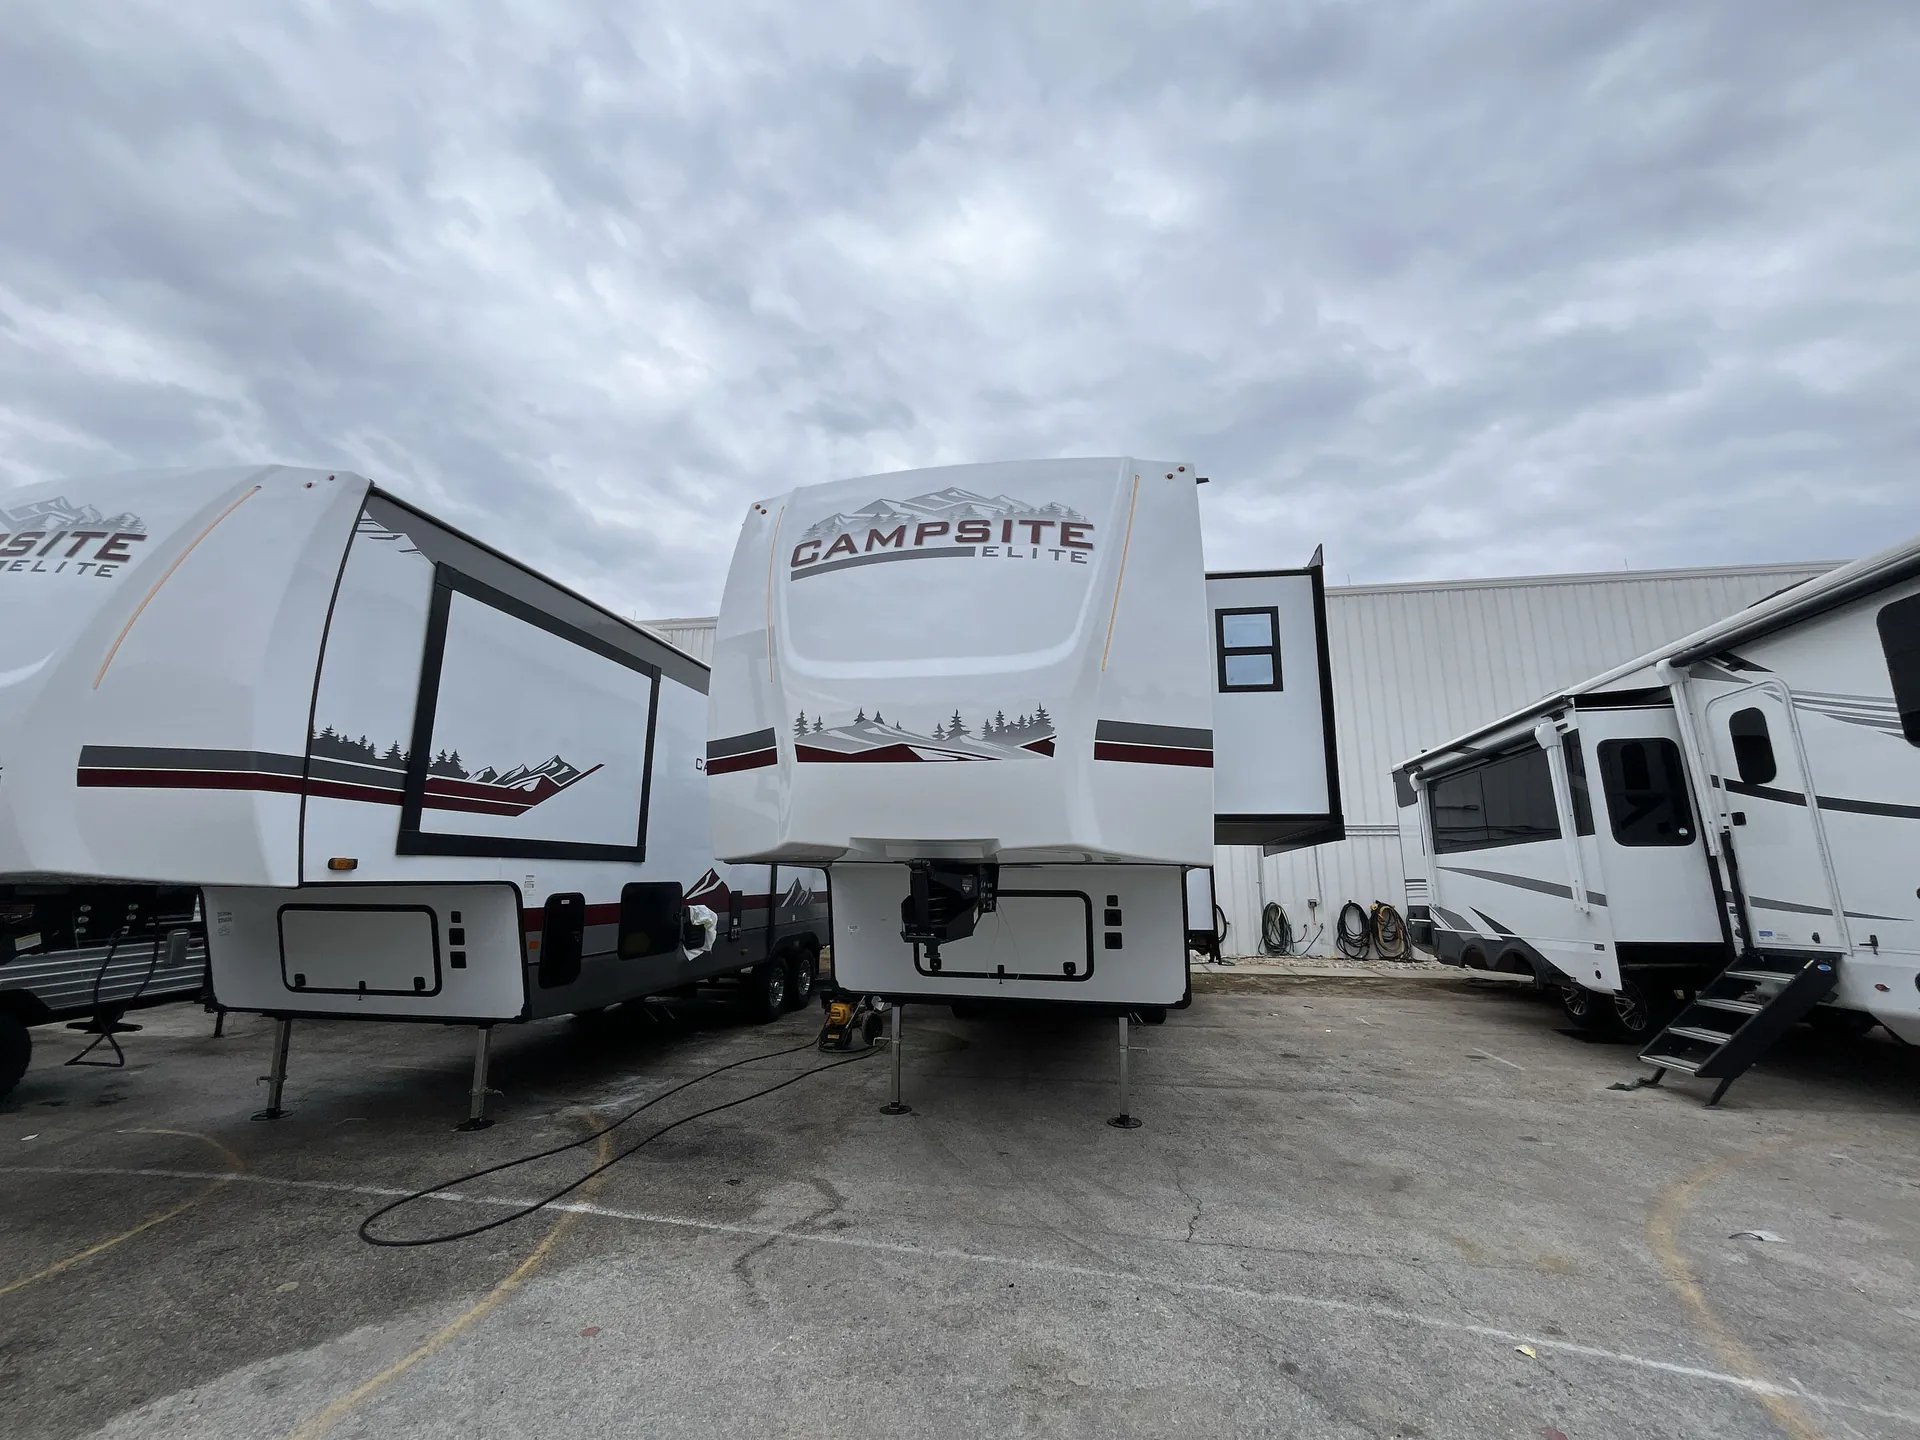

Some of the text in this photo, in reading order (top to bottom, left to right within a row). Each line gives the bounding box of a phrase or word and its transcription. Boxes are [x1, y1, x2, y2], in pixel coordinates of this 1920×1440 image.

[0, 530, 148, 562] SITE
[790, 519, 1094, 568] CAMPSITE
[982, 546, 1088, 565] ELITE
[7, 560, 119, 578] ELITE
